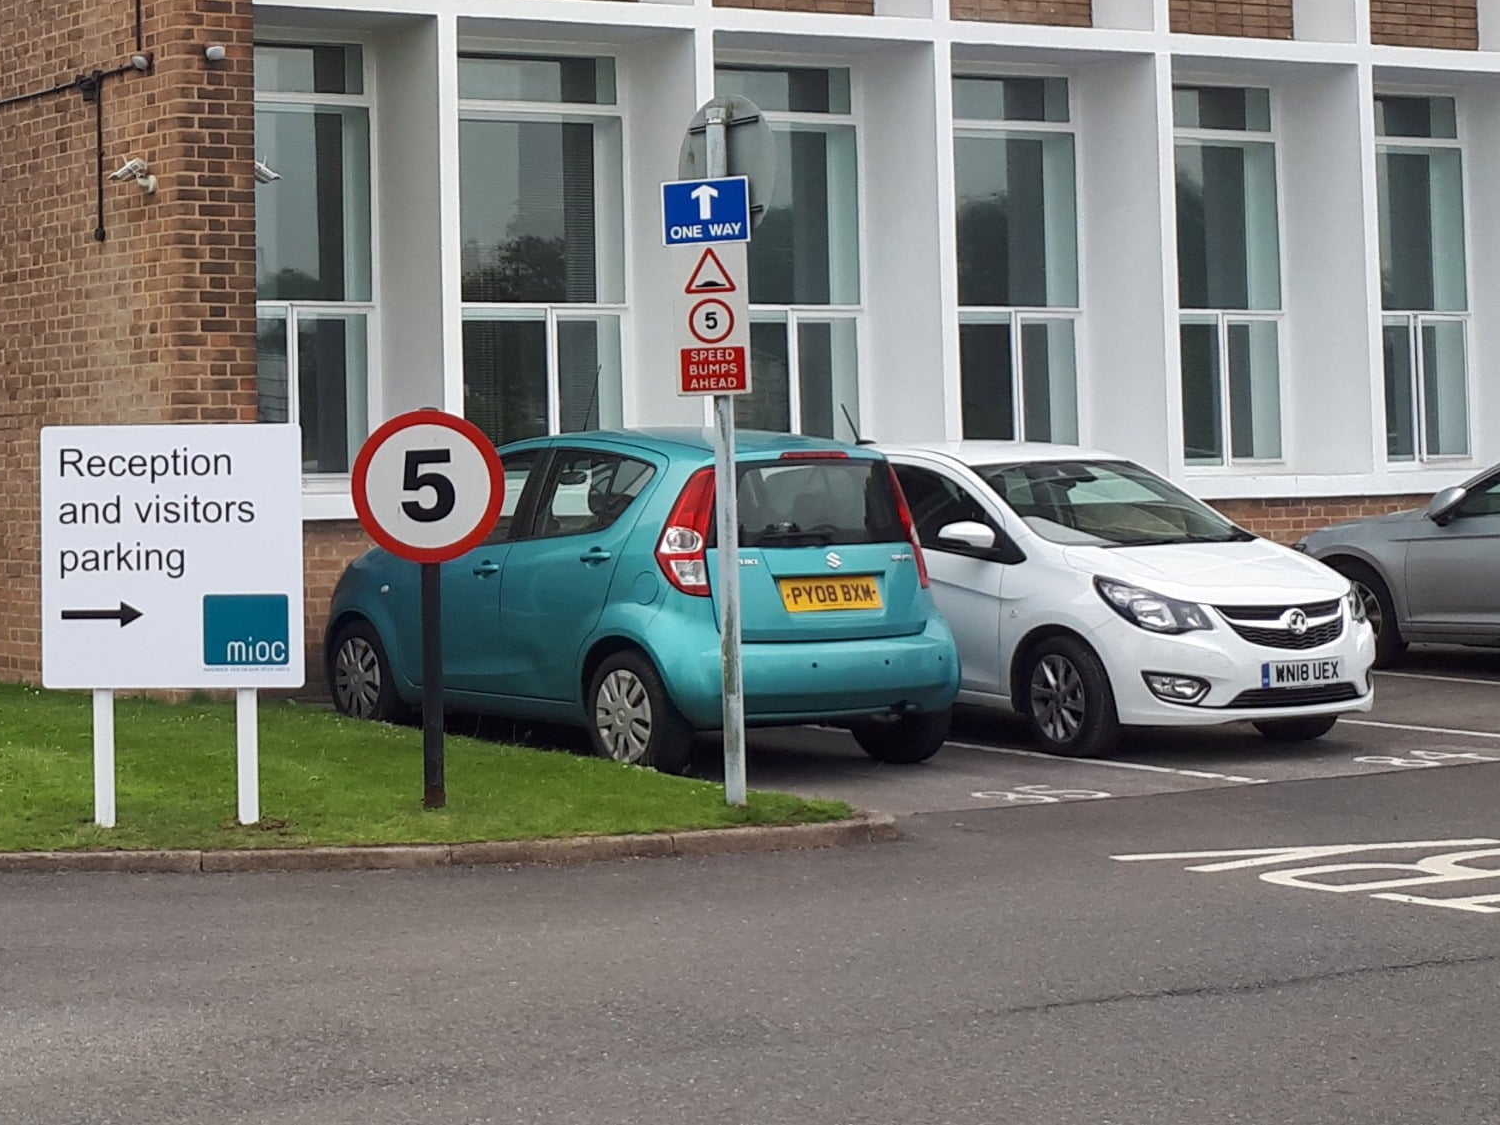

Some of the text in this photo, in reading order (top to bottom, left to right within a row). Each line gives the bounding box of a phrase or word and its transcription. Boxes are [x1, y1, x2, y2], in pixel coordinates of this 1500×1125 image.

[670, 222, 742, 240] ONE WAY
[704, 312, 718, 330] 5
[690, 348, 735, 361] SPEED
[689, 363, 738, 376] BUMPS
[690, 376, 737, 389] AHEAD
[59, 447, 233, 484] Reception
[401, 448, 456, 523] 5
[59, 494, 256, 524] and visitors
[60, 542, 185, 579] parking
[790, 583, 873, 604] PY08 BXM
[227, 636, 286, 663] mioc
[1275, 660, 1339, 683] WN18 UEX
